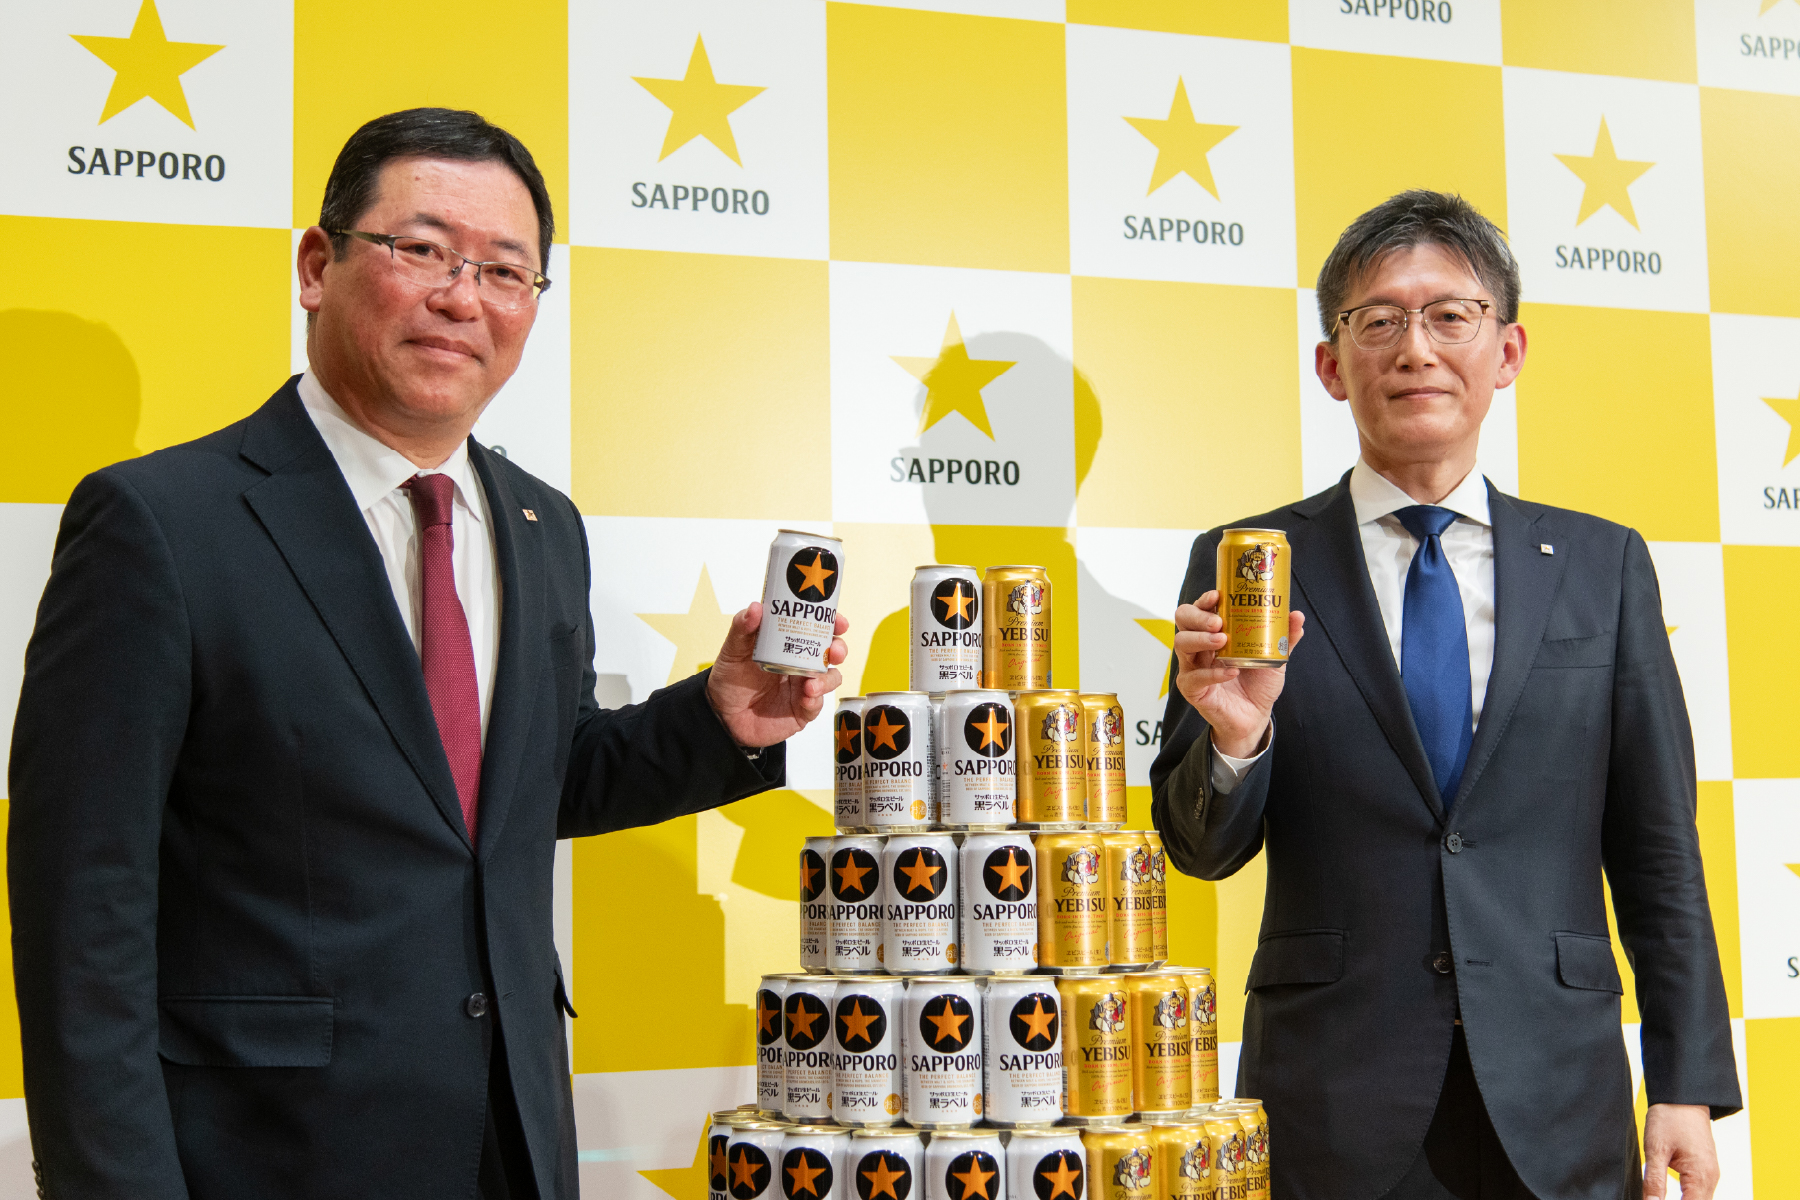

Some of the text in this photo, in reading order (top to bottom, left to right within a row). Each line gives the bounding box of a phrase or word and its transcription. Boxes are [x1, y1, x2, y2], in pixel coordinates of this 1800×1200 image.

[1740, 33, 1800, 60] SAPP
[67, 145, 226, 182] SAPPORO
[631, 181, 770, 216] SAPPORO
[1123, 214, 1244, 247] SAPPORO
[1555, 244, 1662, 275] SAPPORO
[889, 457, 1021, 487] SAPPORO
[1235, 581, 1275, 593] Premium
[1228, 593, 1282, 608] YEBISU
[998, 627, 1049, 642] YEBISU
[782, 642, 820, 657] 黒ラベル
[938, 670, 974, 680] 黒ラベル
[1033, 754, 1084, 769] YEBISU
[869, 802, 905, 813] 黒ラベル
[974, 801, 1009, 811] 黒ラベル
[1061, 886, 1101, 898] Premium
[1053, 897, 1106, 912] YEBISU
[1113, 896, 1152, 911] YEBIS
[887, 903, 955, 921] SAPPORO
[835, 946, 871, 957] 黒ラベル
[901, 946, 941, 957] 黒ラベル
[993, 946, 1030, 957] 黒ラベル
[1088, 1034, 1127, 1046] Premium
[1080, 1045, 1131, 1062] YEBISU
[1144, 1040, 1191, 1058] YEBISU
[911, 1053, 981, 1072] SAPPORO
[787, 1092, 821, 1103] 黒ラベル
[841, 1096, 879, 1108] 黒ラベル
[929, 1097, 969, 1109] 黒ラベル
[1020, 1095, 1057, 1108] 黒ラベル
